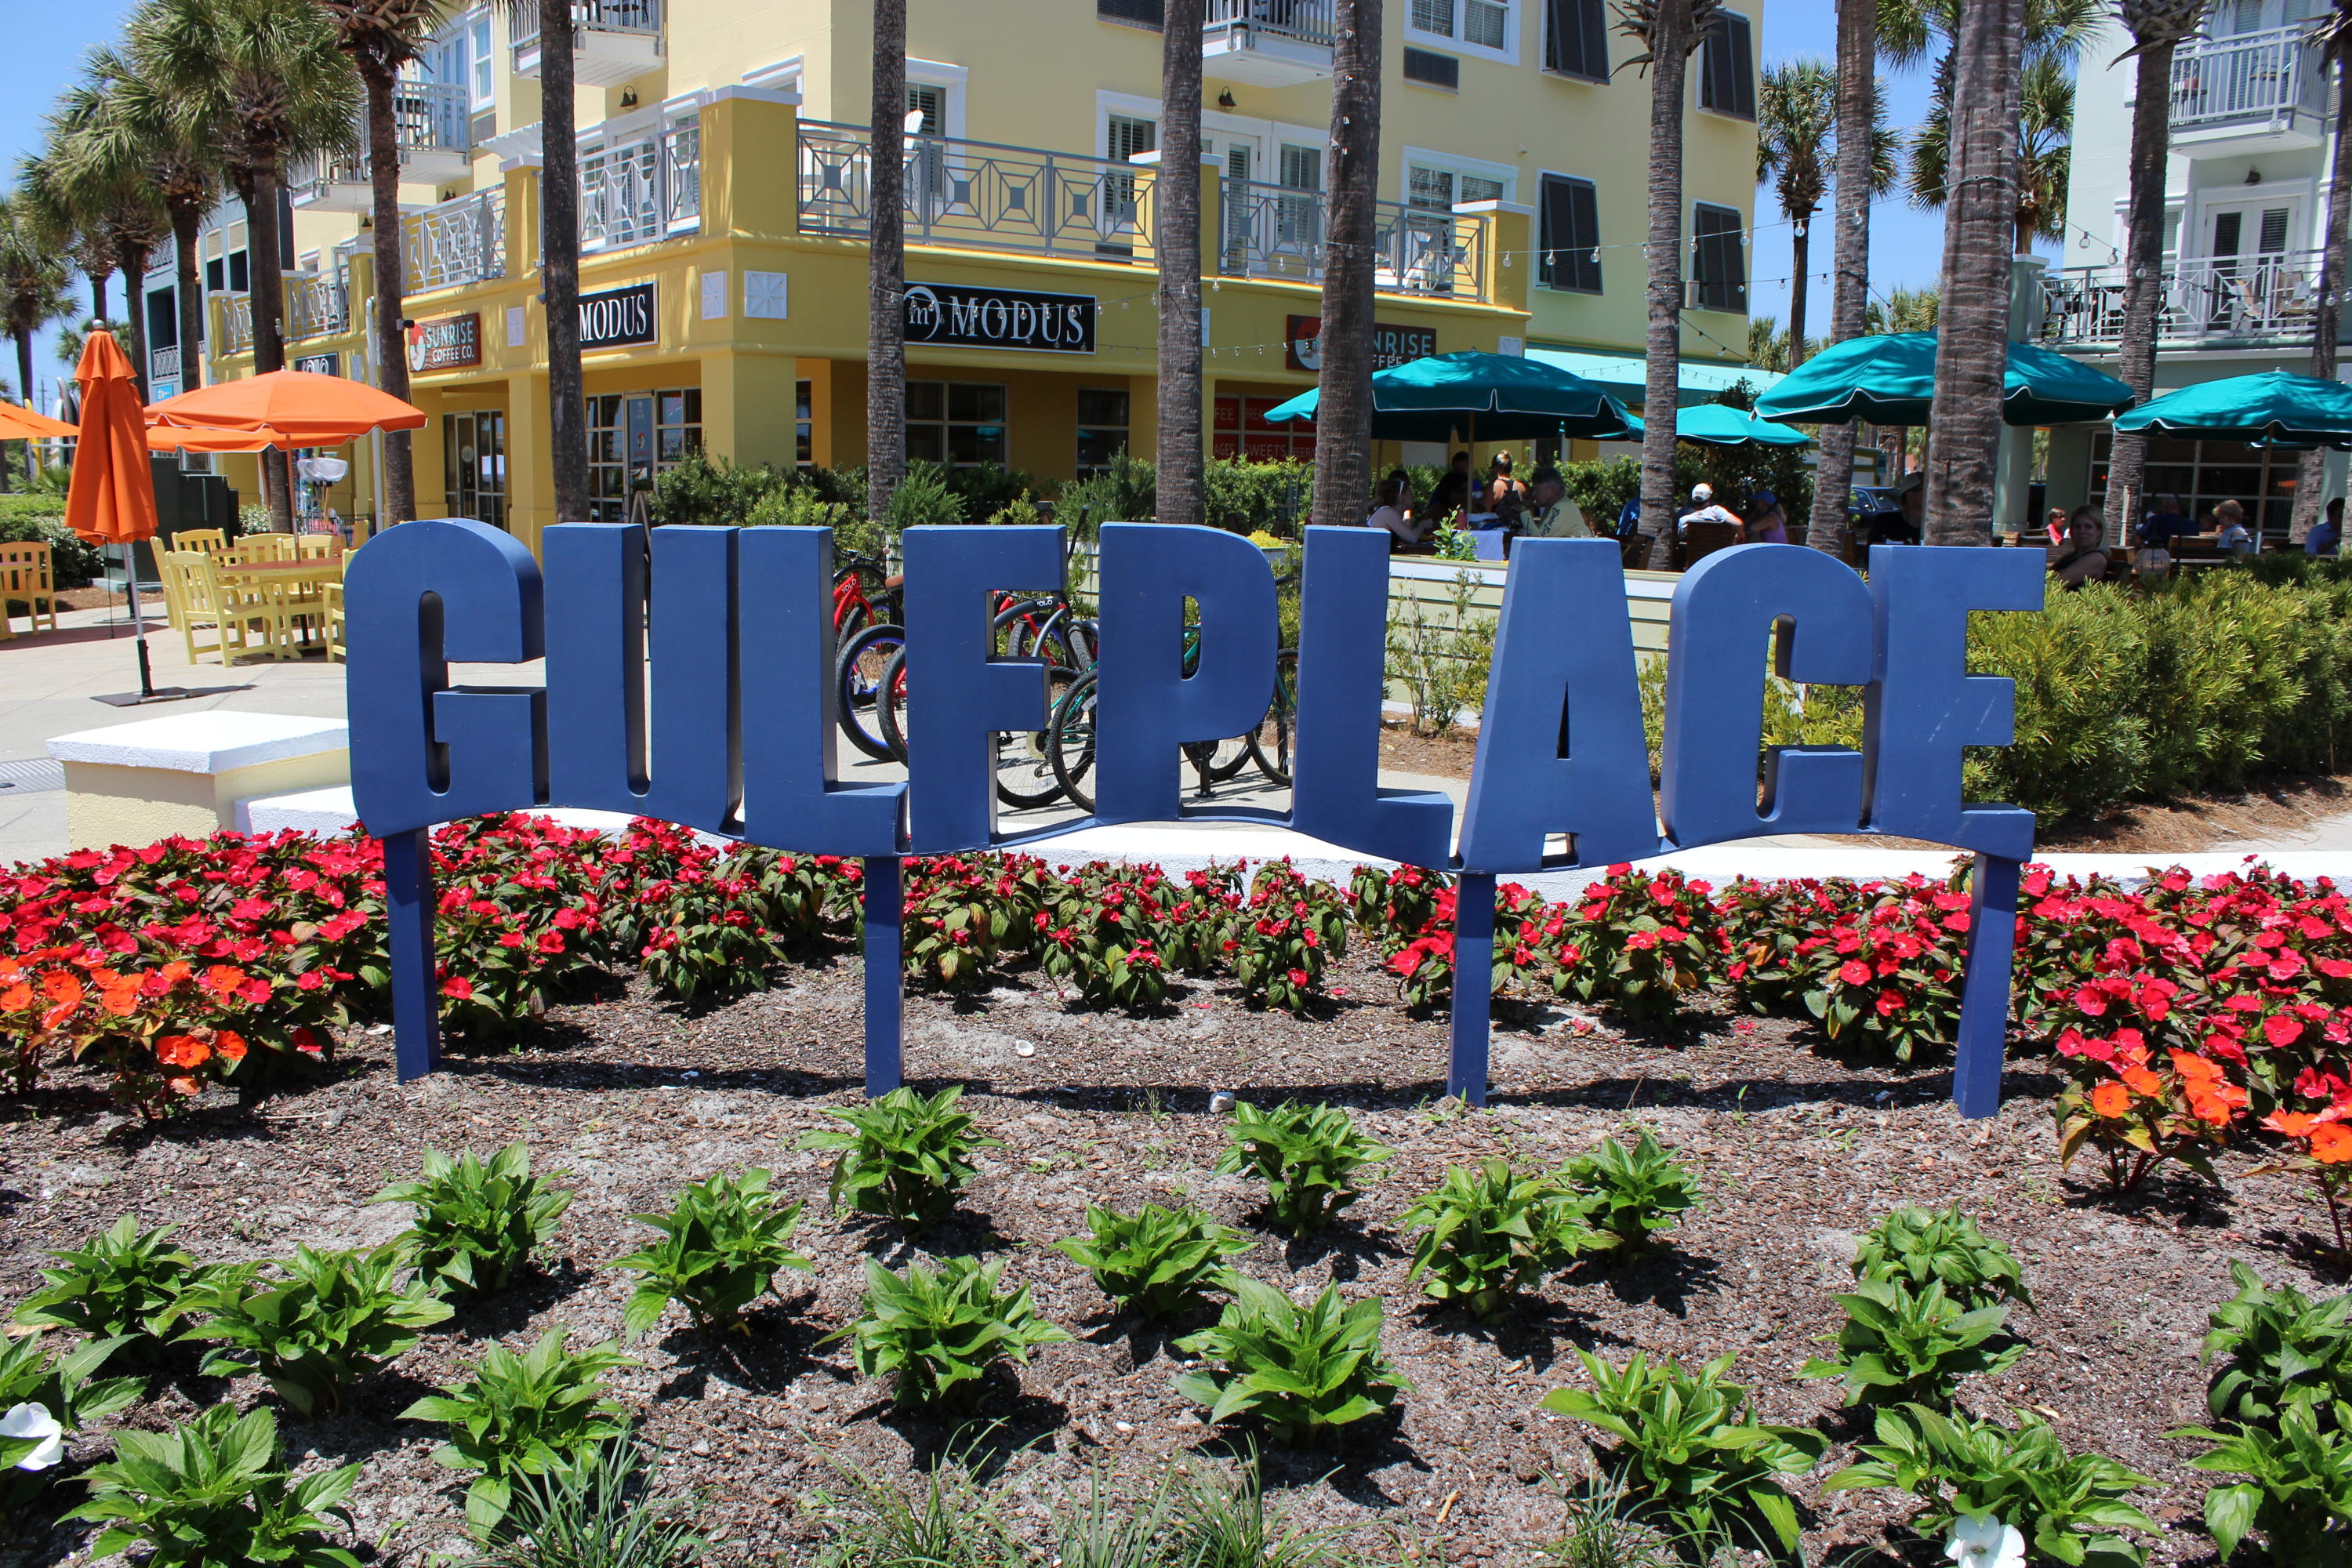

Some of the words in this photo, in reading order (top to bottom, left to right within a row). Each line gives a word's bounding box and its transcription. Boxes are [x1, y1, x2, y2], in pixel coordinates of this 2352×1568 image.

[578, 293, 647, 342] MODUS
[948, 295, 1083, 344] MODUS
[426, 321, 474, 349] SUNRISE
[432, 347, 459, 363] COFFEE
[461, 345, 475, 359] CO.
[1243, 444, 1287, 458] SWEETS
[841, 578, 857, 594] YOLO
